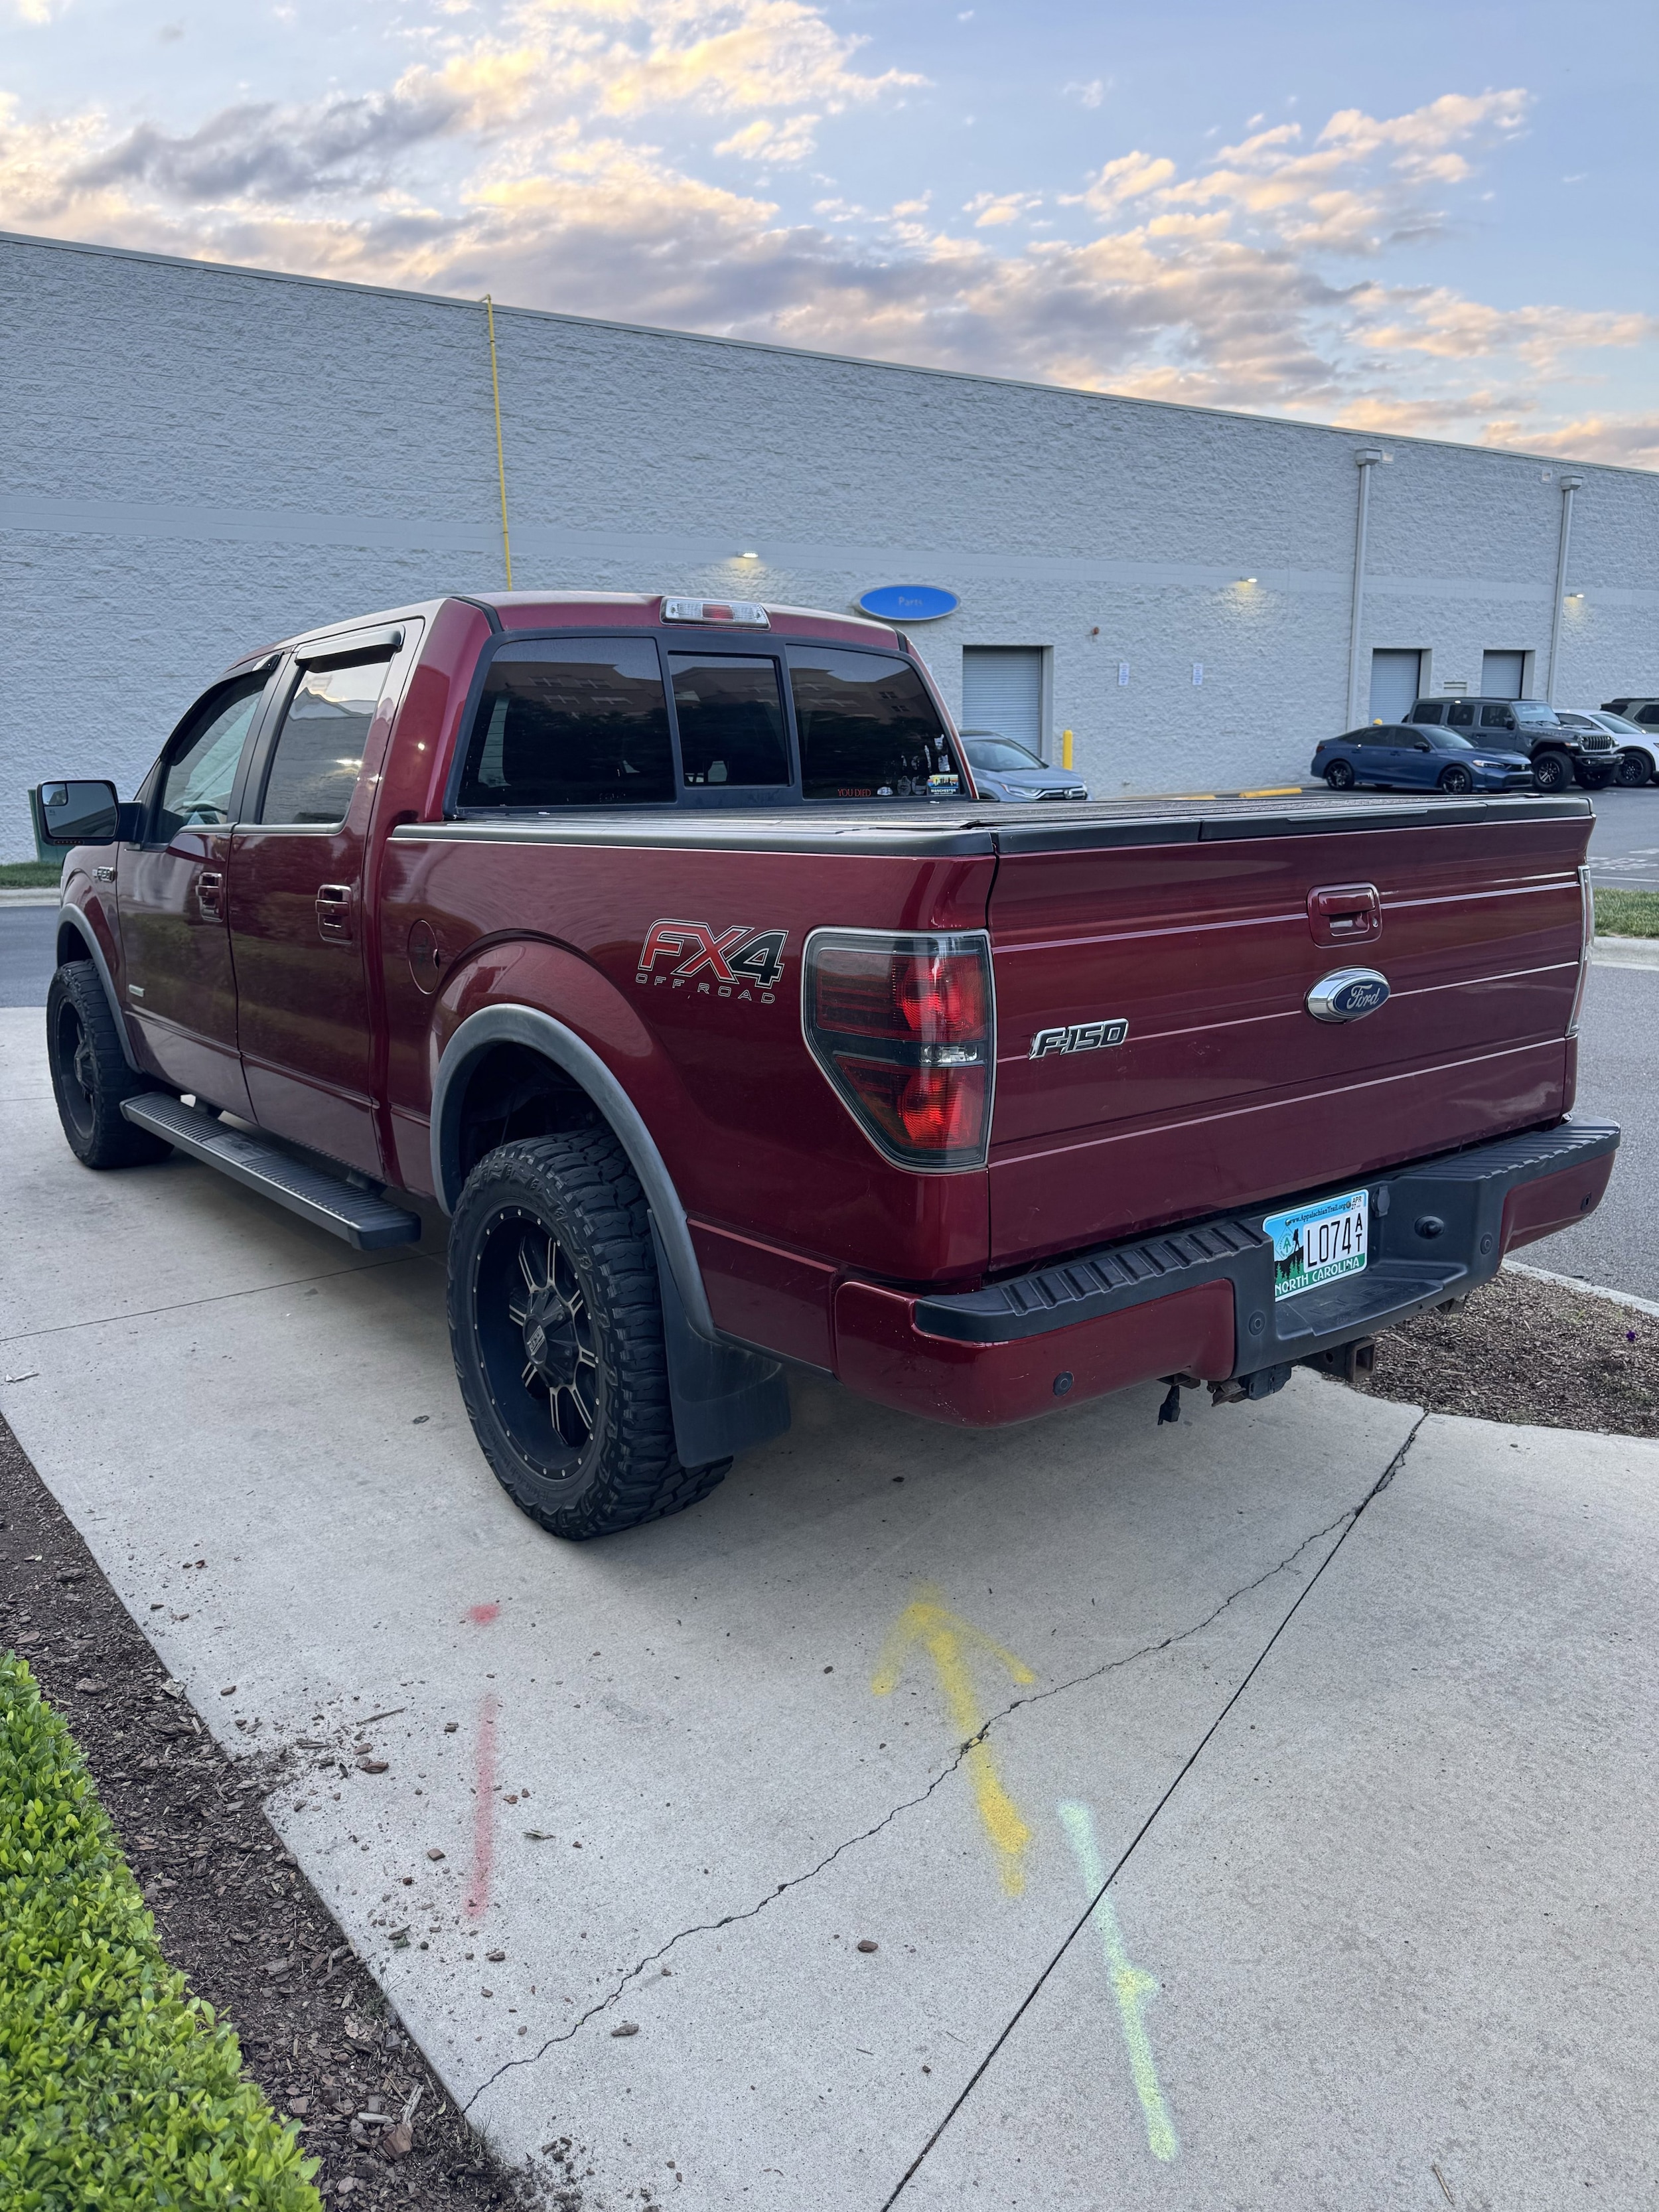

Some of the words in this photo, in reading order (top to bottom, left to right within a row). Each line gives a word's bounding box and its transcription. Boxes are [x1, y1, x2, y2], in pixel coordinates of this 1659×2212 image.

[898, 596, 924, 607] Parts
[637, 918, 789, 989] FX4
[635, 973, 685, 988] OFF
[697, 983, 776, 1004] ROAD
[1346, 984, 1381, 1009] Ford
[1275, 1274, 1309, 1296] NORTH
[1312, 1256, 1360, 1283] CAROLINA
